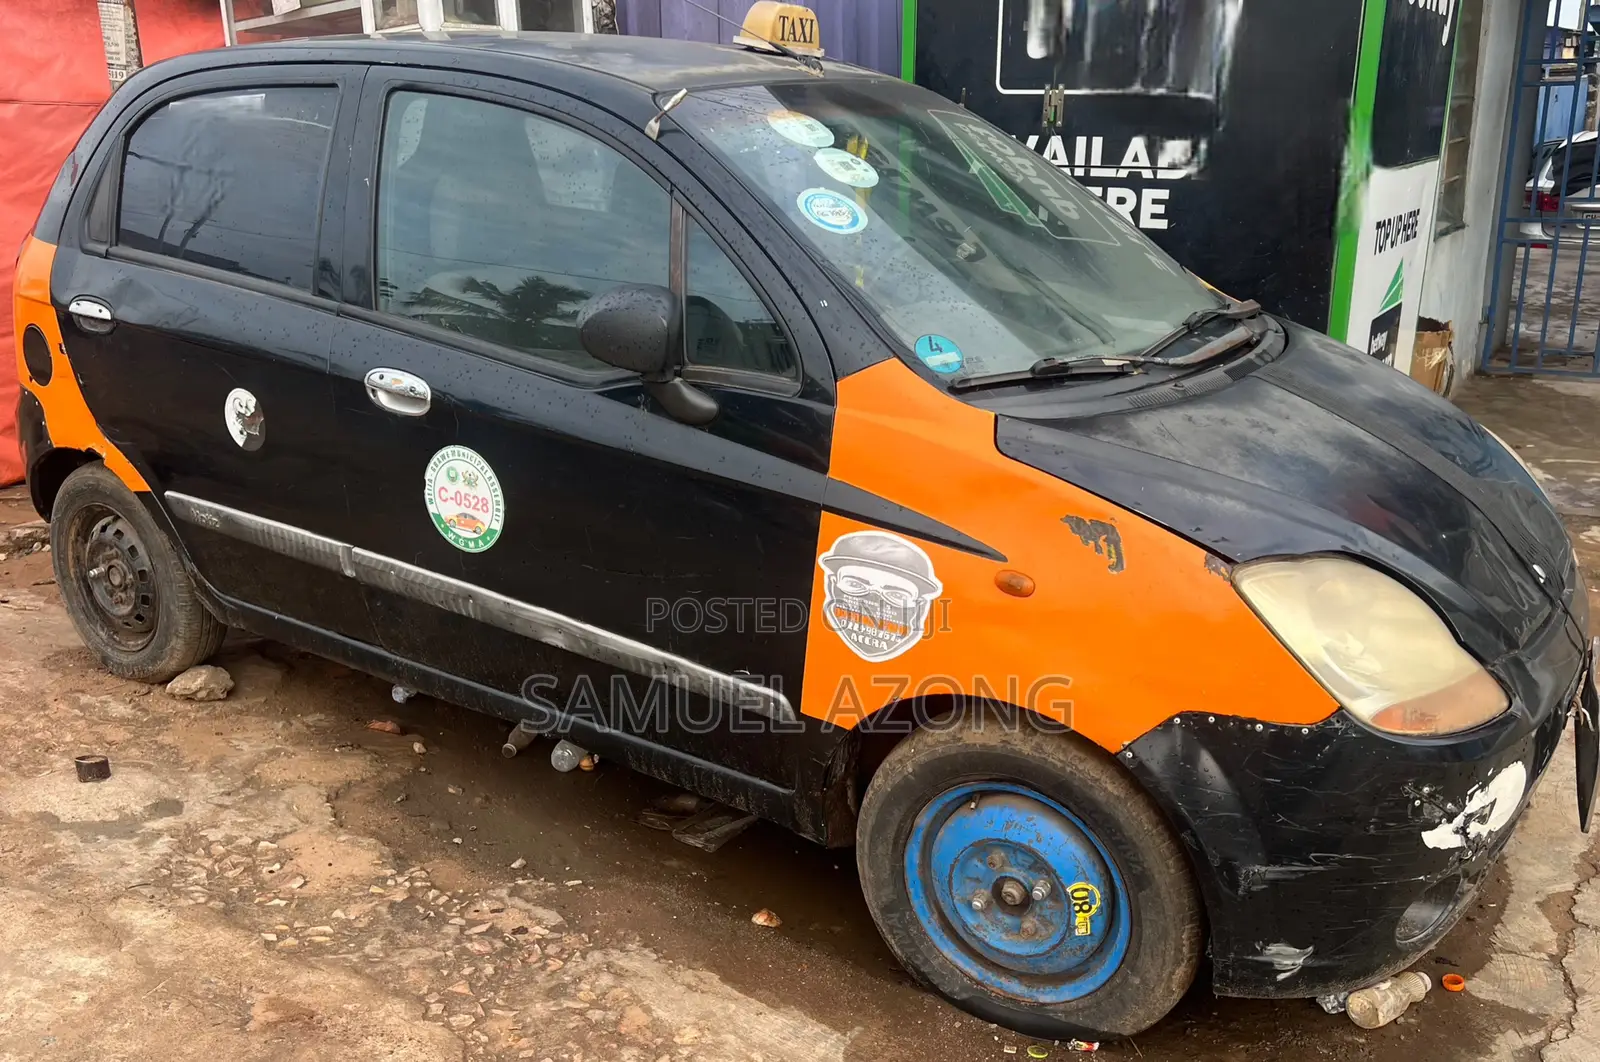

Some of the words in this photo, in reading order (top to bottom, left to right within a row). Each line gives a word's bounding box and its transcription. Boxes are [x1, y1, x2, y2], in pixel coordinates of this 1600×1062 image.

[779, 15, 815, 44] TAXI
[1374, 217, 1391, 256] TOP
[1390, 214, 1402, 249] UP
[1400, 208, 1420, 244] HERE
[928, 335, 943, 352] 4
[438, 486, 489, 514] C-0528
[850, 632, 888, 651] ACCRA
